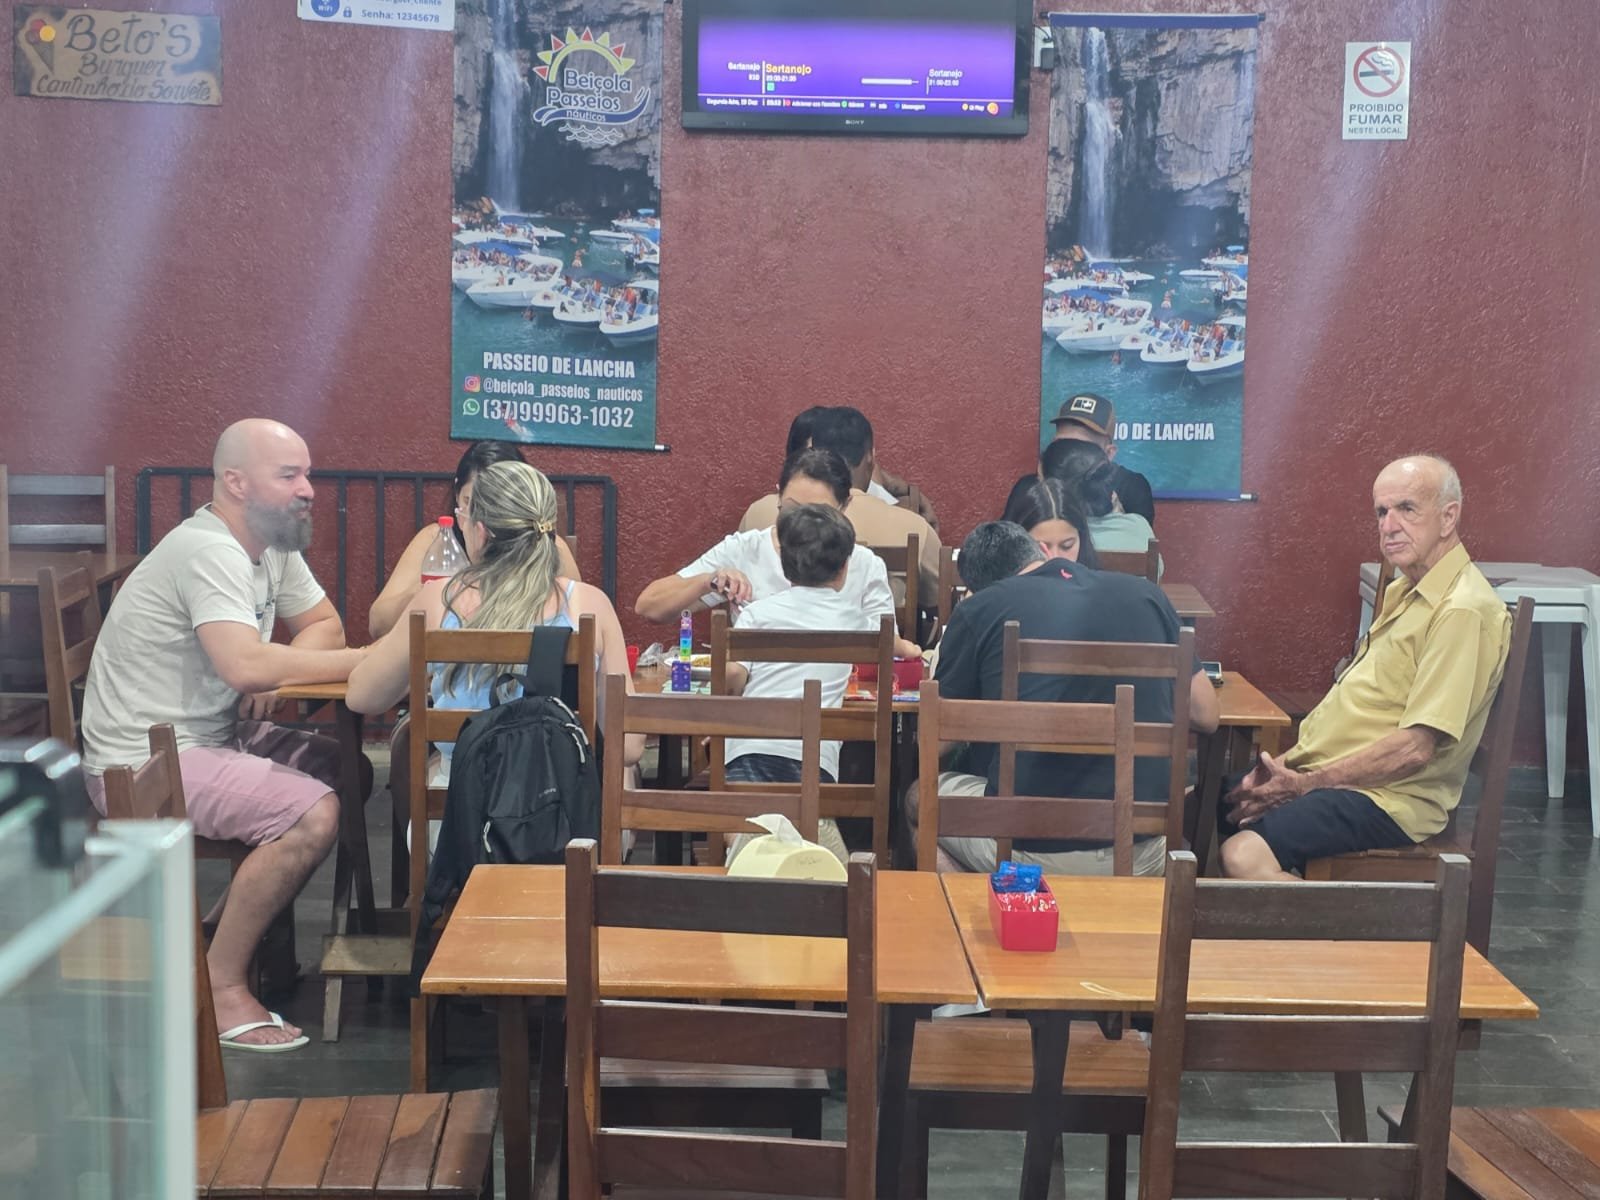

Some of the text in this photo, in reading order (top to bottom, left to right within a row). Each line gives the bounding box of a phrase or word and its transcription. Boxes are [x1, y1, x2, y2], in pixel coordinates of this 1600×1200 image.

[361, 9, 440, 23] Senha: 12345678
[766, 63, 812, 76] Sertanejo
[564, 68, 632, 94] Beiçola
[546, 86, 621, 110] Passeios
[1349, 103, 1404, 113] PROIBIDO
[1348, 114, 1403, 125] FUMAR
[483, 351, 636, 378] PASSEIO DE LANCHA
[483, 399, 634, 428] (37)99963-1032
[1131, 422, 1151, 440] DE
[1154, 422, 1216, 441] LANCHA
